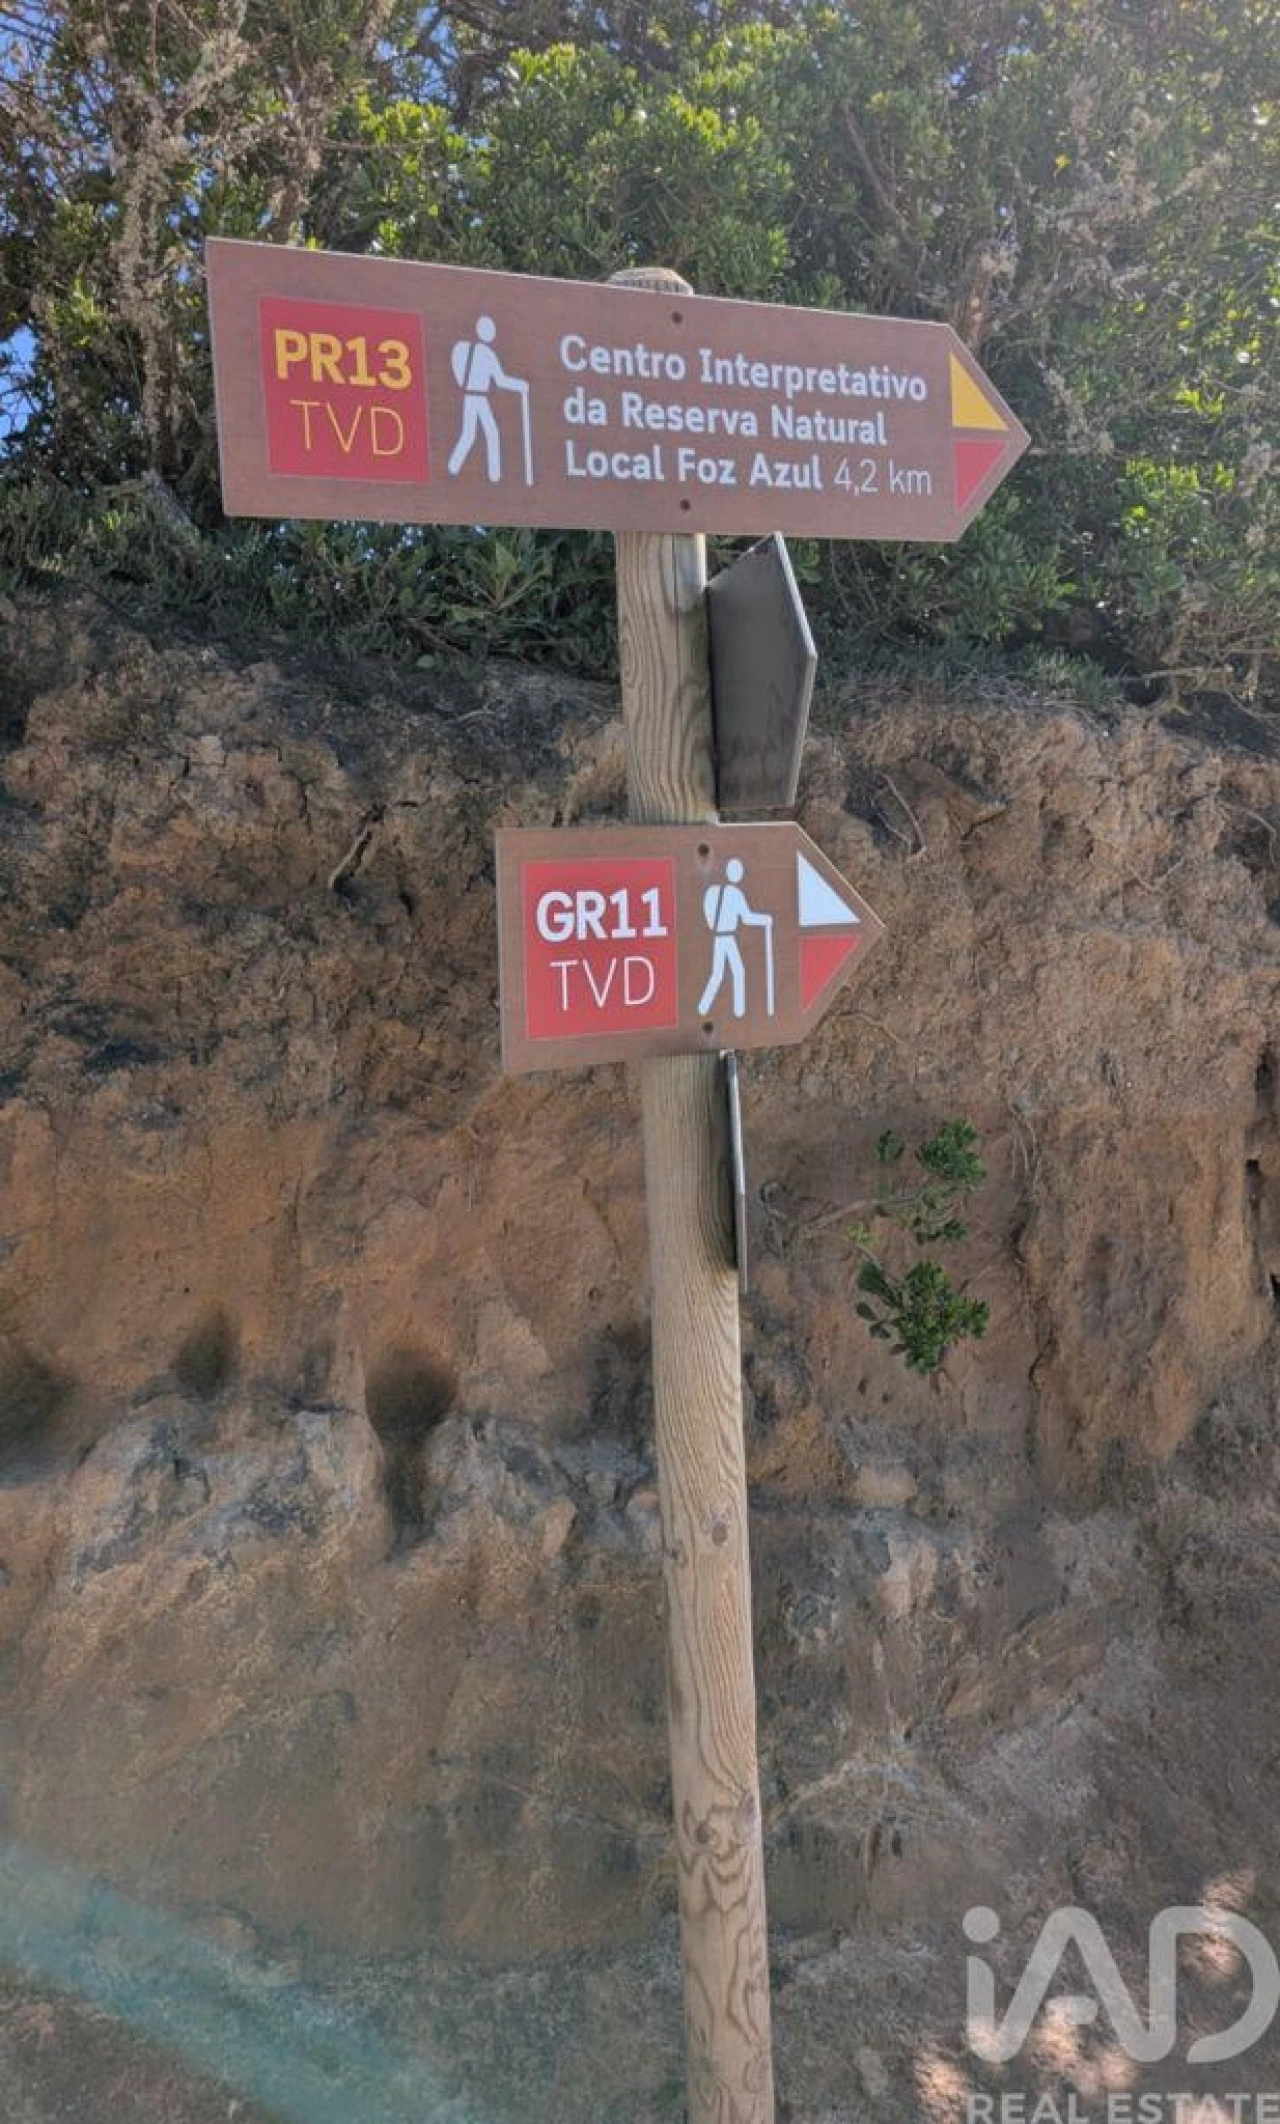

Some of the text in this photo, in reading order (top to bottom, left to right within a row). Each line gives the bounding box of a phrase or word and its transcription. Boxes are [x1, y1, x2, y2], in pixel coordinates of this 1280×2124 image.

[275, 329, 412, 390] PR13
[559, 334, 927, 401] Centro Interpretativo
[290, 400, 404, 456] TVD
[563, 388, 887, 446] da Reserva Natural
[565, 440, 932, 497] Local Foz Azul 4,2 km
[536, 887, 668, 943] GR11
[550, 955, 655, 1011] TVD
